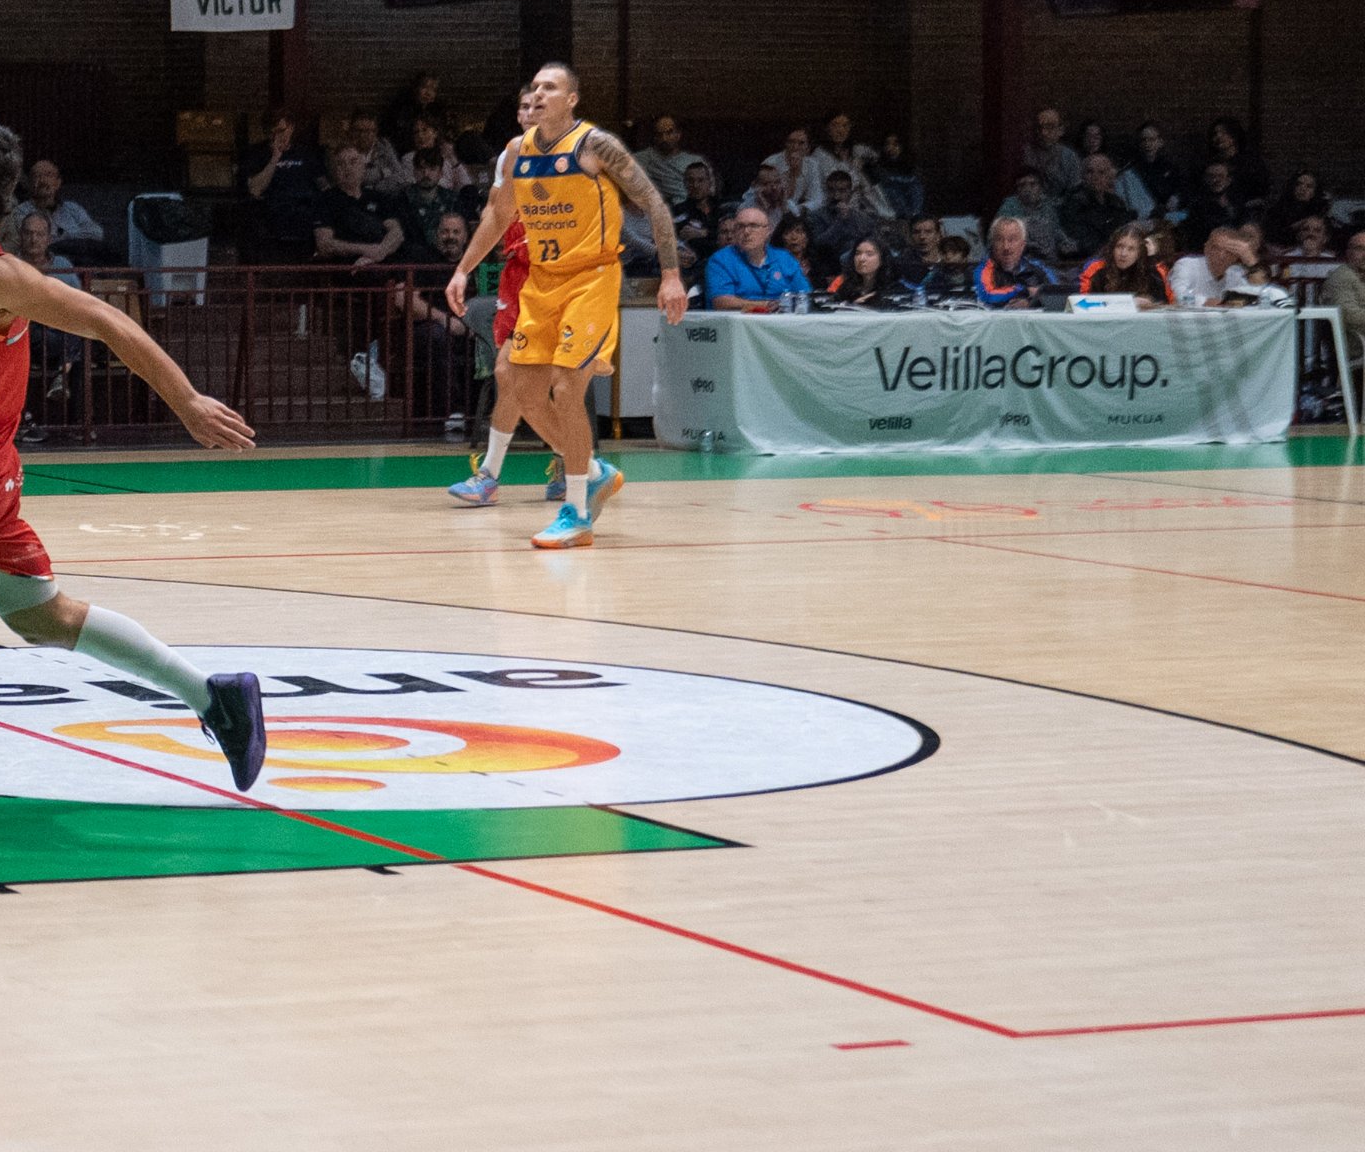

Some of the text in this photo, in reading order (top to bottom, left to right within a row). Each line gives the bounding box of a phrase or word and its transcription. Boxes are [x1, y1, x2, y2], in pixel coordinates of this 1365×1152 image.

[538, 239, 561, 262] 23
[873, 344, 1169, 400] VelillaGroup.
[1107, 414, 1164, 425] MUKUA
